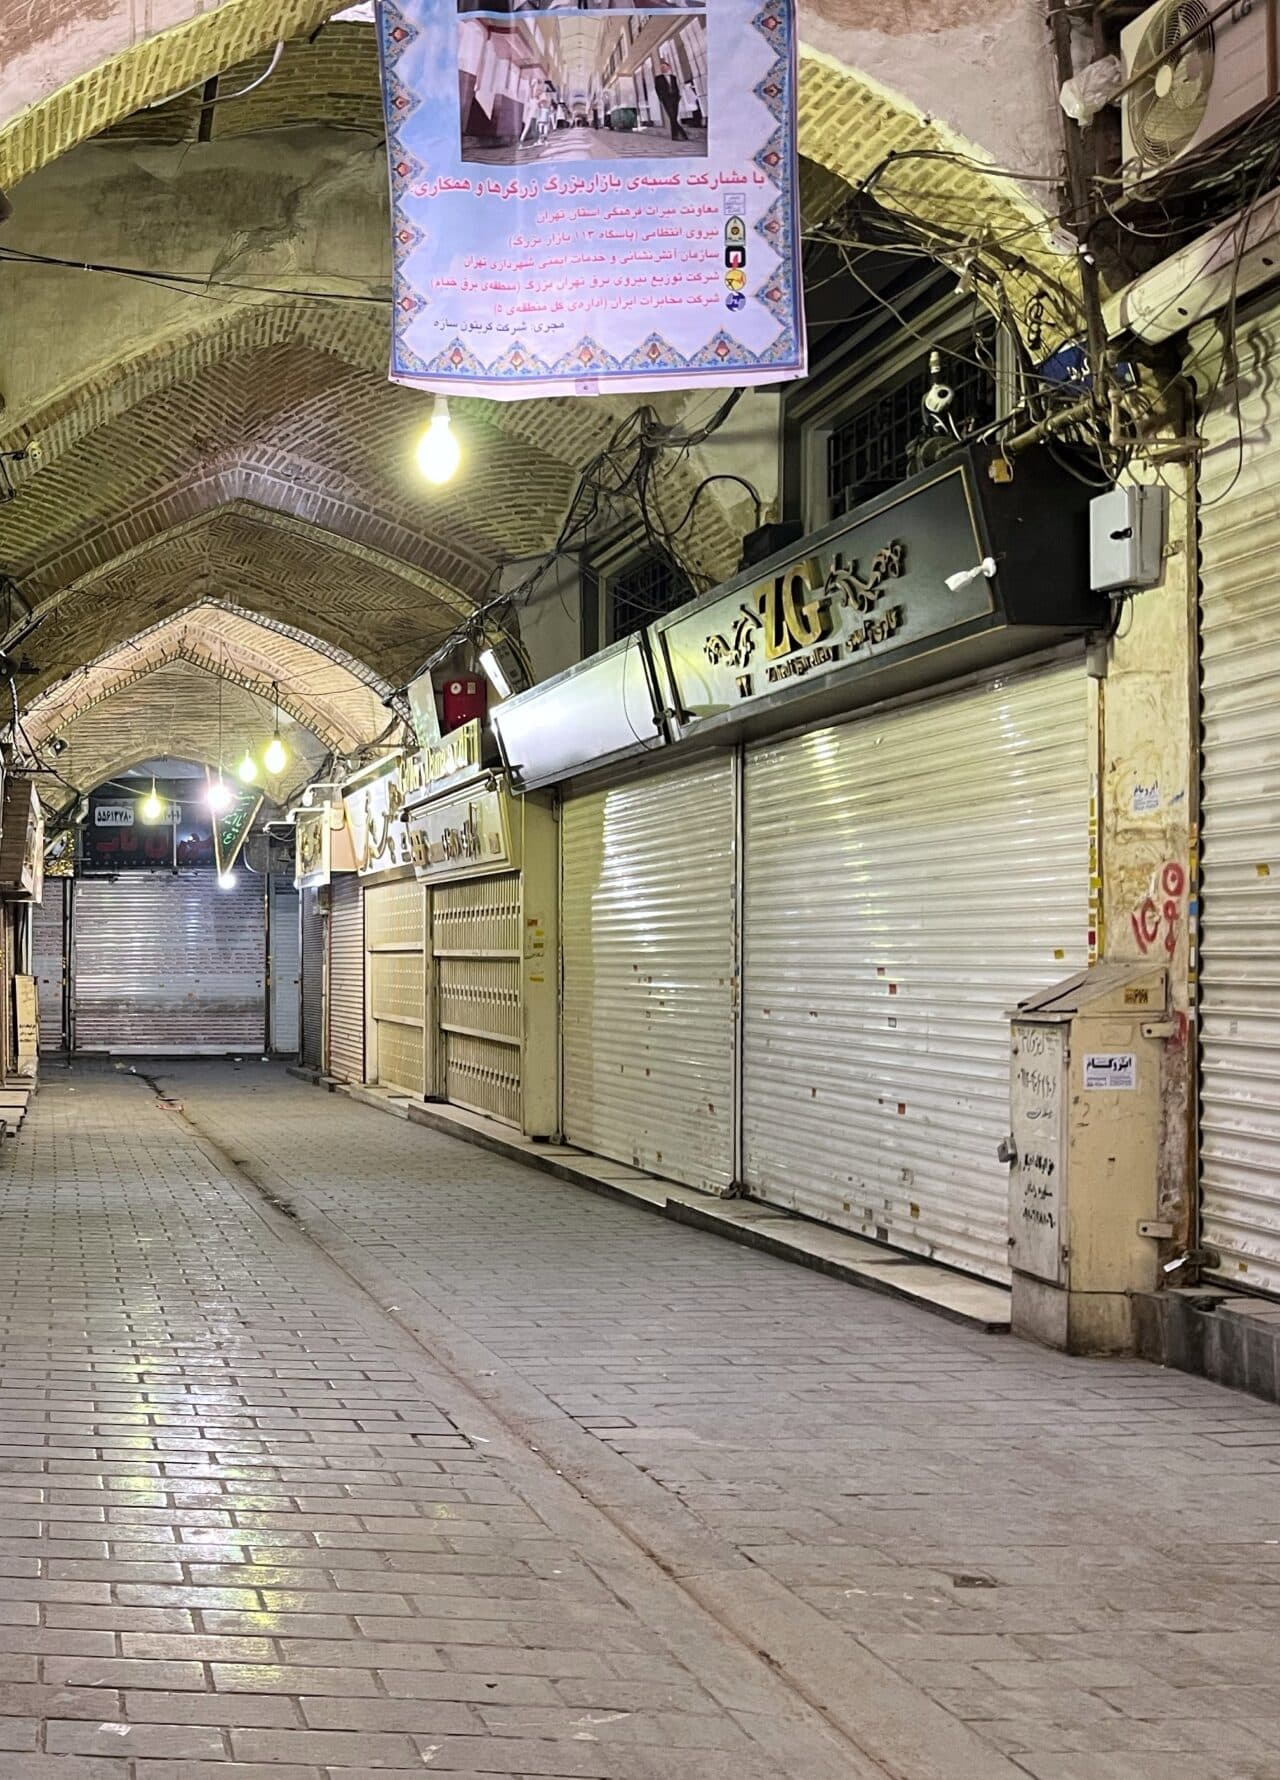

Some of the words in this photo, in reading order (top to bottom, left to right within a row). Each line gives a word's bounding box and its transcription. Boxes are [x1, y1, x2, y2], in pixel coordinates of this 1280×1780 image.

[686, 171, 748, 190] مشارکت
[752, 171, 766, 189] با
[475, 183, 484, 197] و
[487, 180, 539, 199] زرگرها
[537, 210, 565, 224] تهران
[570, 207, 600, 221] استان
[604, 206, 642, 219] فرهنگی
[646, 206, 677, 218] میراث
[680, 203, 719, 217] معاونت
[547, 232, 570, 246] بازار
[642, 227, 682, 241] انتظامی
[686, 226, 719, 240] نیروی
[571, 253, 606, 264] خدمات
[610, 255, 617, 264] و
[681, 248, 719, 262] سازمان
[464, 256, 487, 269] تهران
[489, 256, 535, 272] شهرداری
[539, 256, 567, 269] ایمنی
[557, 275, 585, 290] تهران
[614, 276, 647, 287] نیروی
[651, 272, 683, 287] توزیع
[686, 271, 720, 284] شرکت
[525, 280, 553, 292] بزرگ
[611, 296, 637, 310] ایران
[640, 295, 683, 309] مخابرات
[686, 293, 720, 307] شرکت
[433, 318, 458, 331] سازه
[496, 321, 527, 336] شرکت
[752, 558, 823, 661] ZG
